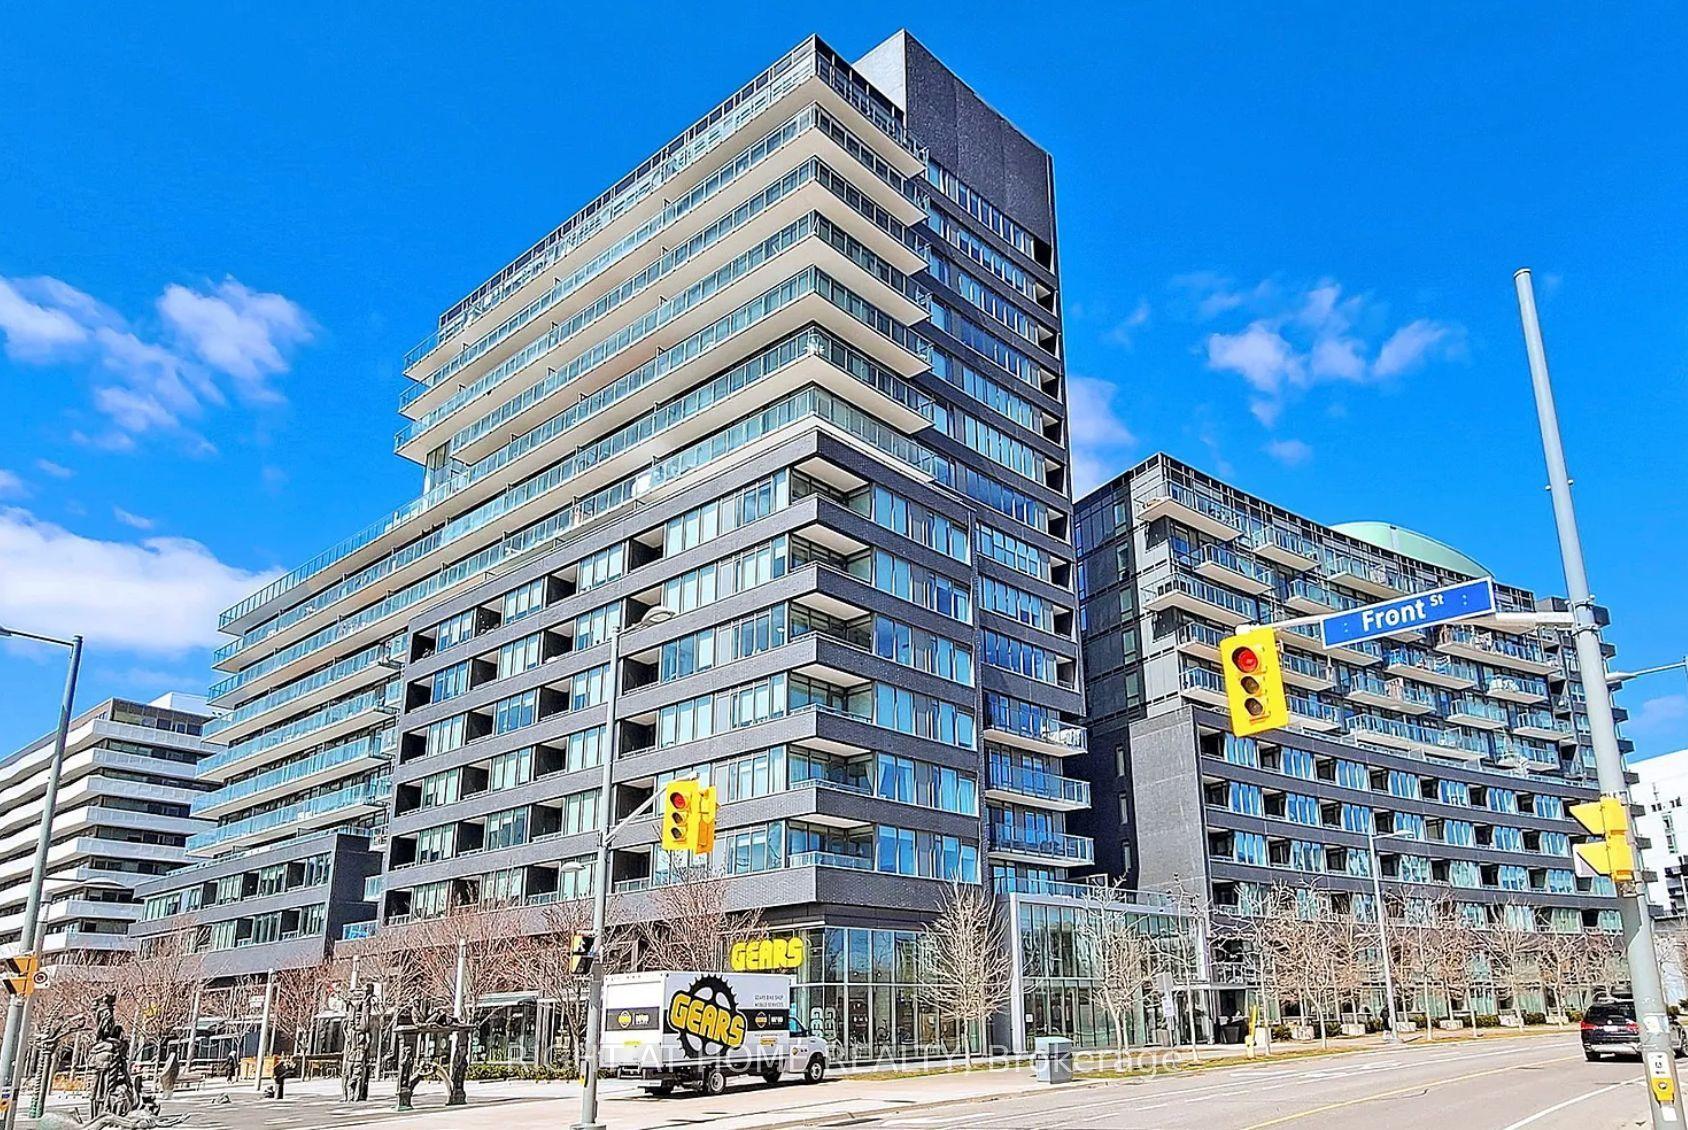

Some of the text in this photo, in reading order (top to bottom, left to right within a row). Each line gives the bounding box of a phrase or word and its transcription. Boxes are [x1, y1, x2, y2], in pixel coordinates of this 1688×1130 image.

[1361, 593, 1444, 632] Front St
[730, 937, 804, 971] GEARS
[669, 993, 746, 1050] GEARS
